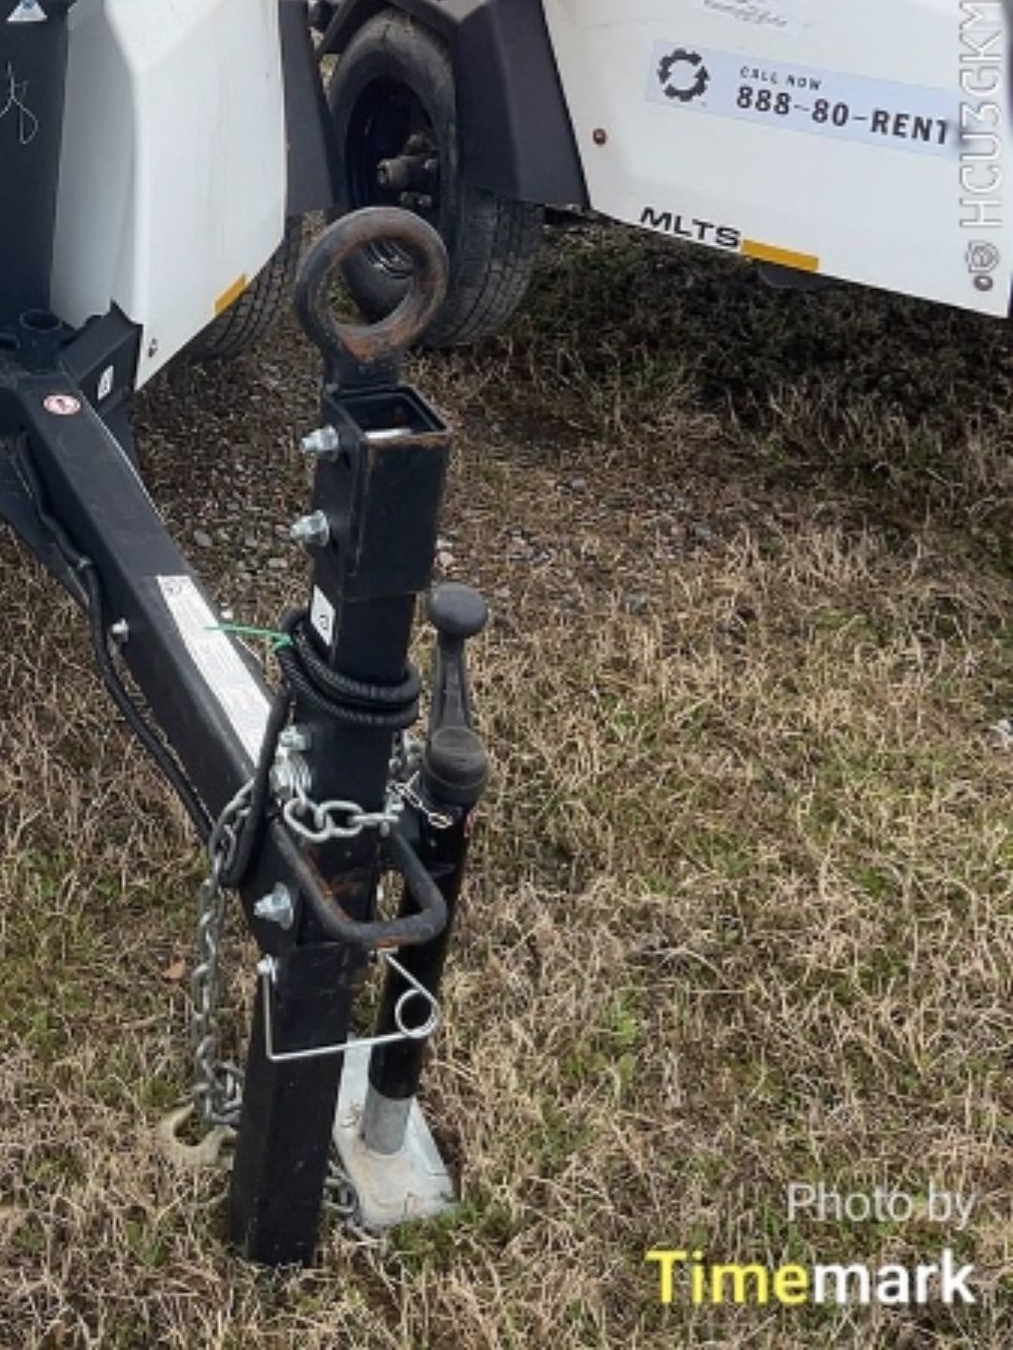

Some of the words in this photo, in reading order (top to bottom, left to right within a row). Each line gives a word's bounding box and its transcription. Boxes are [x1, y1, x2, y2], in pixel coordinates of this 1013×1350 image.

[740, 65, 778, 85] CALL
[787, 74, 822, 91] NOW
[737, 85, 952, 146] 888-80-RENT
[639, 206, 742, 247] MLTS
